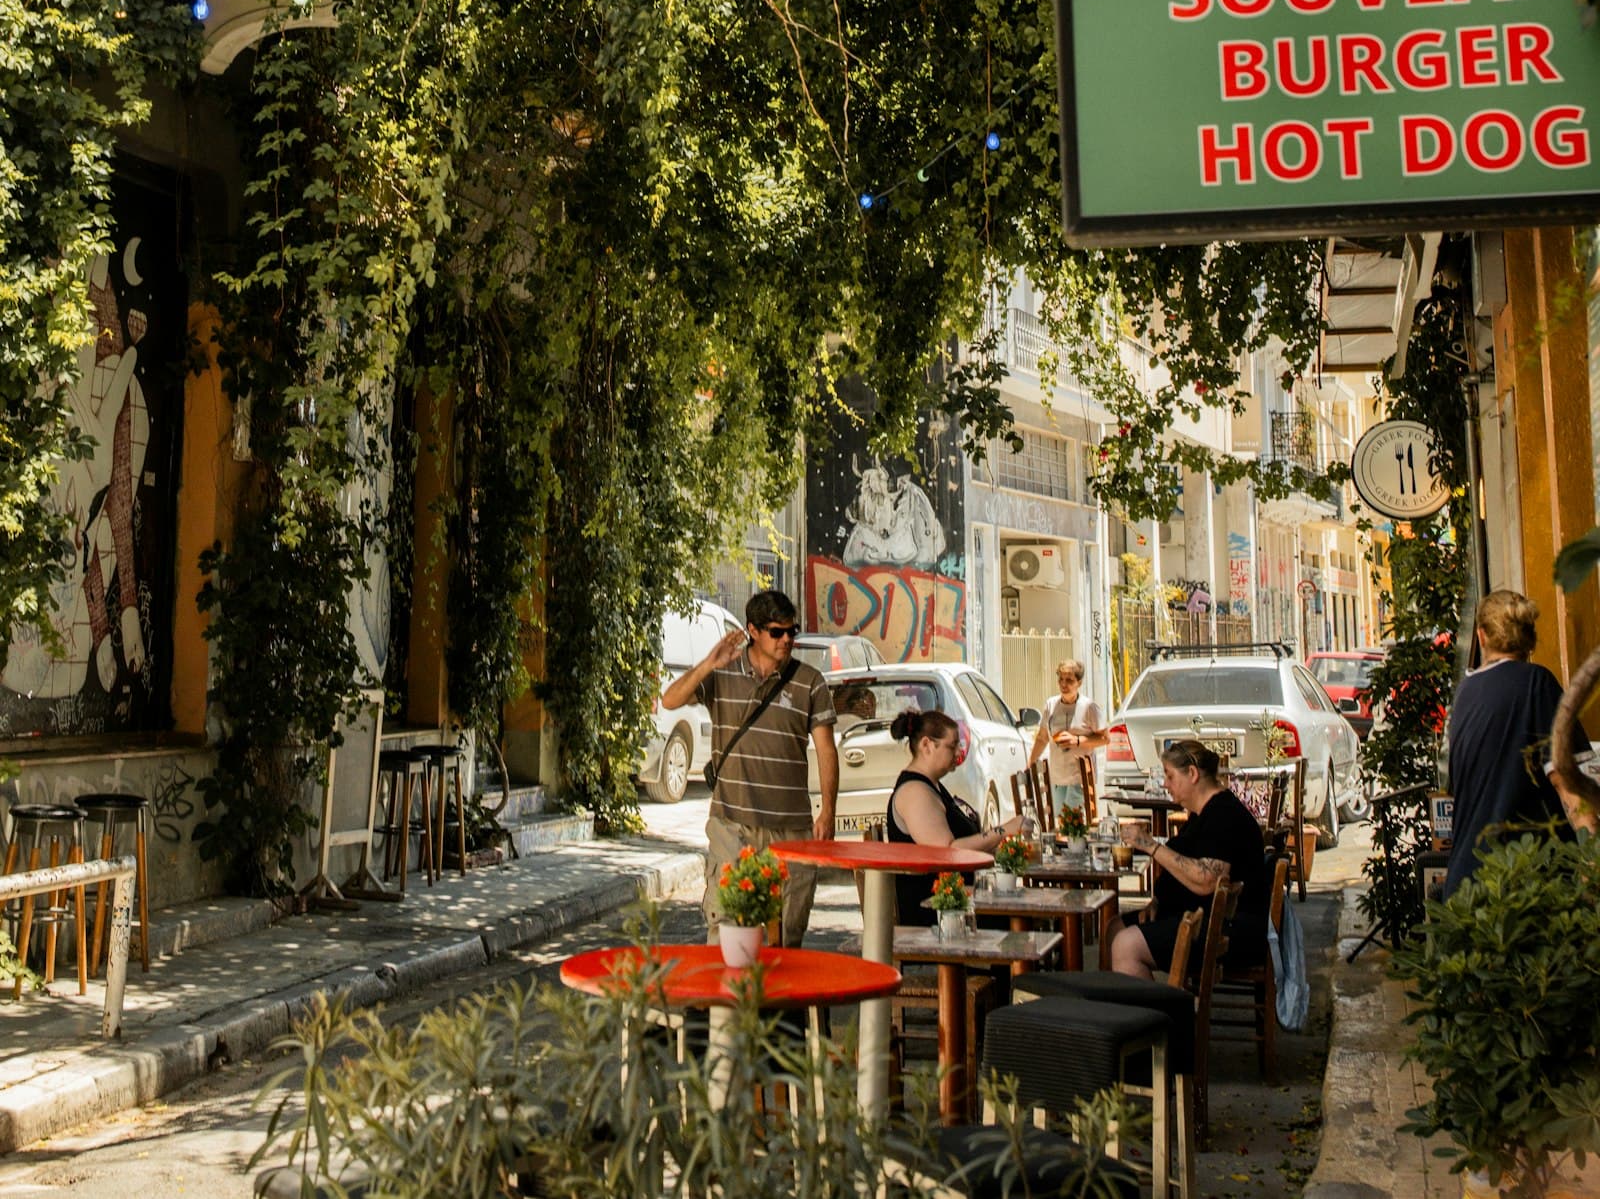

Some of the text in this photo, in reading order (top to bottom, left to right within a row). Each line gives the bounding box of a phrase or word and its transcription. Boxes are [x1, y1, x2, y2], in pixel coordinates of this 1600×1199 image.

[1218, 23, 1564, 101] BURGER
[1198, 105, 1591, 186] HOT DOG
[1371, 430, 1428, 454] GREEK FOO
[1375, 486, 1408, 507] GREEK
